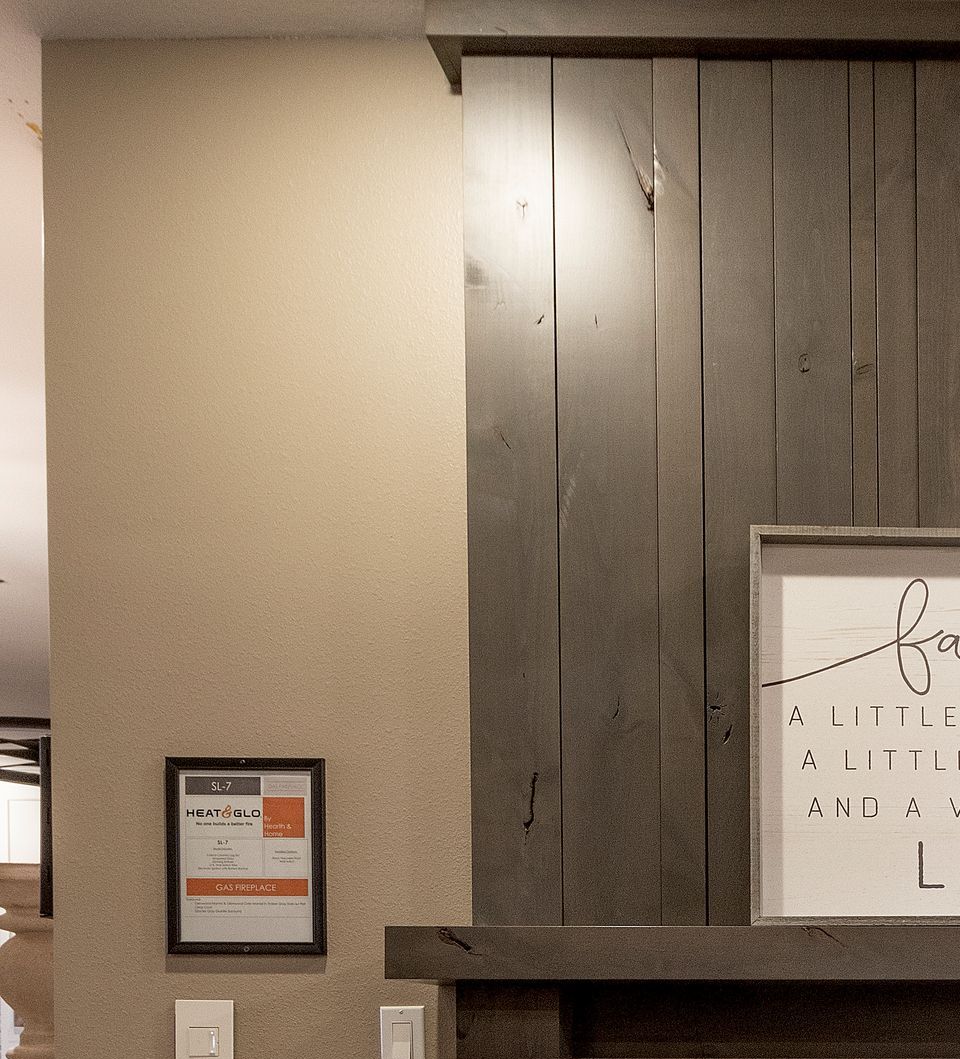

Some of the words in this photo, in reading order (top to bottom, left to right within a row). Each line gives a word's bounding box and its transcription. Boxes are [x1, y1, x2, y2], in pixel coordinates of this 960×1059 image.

[788, 705, 804, 726] A
[832, 705, 957, 727] LITTLE
[801, 749, 817, 770] A
[211, 781, 232, 792] SL-7
[807, 796, 879, 818] AND
[905, 797, 921, 818] A
[215, 883, 234, 892] GAS
[235, 884, 277, 892] FIREPLACE
